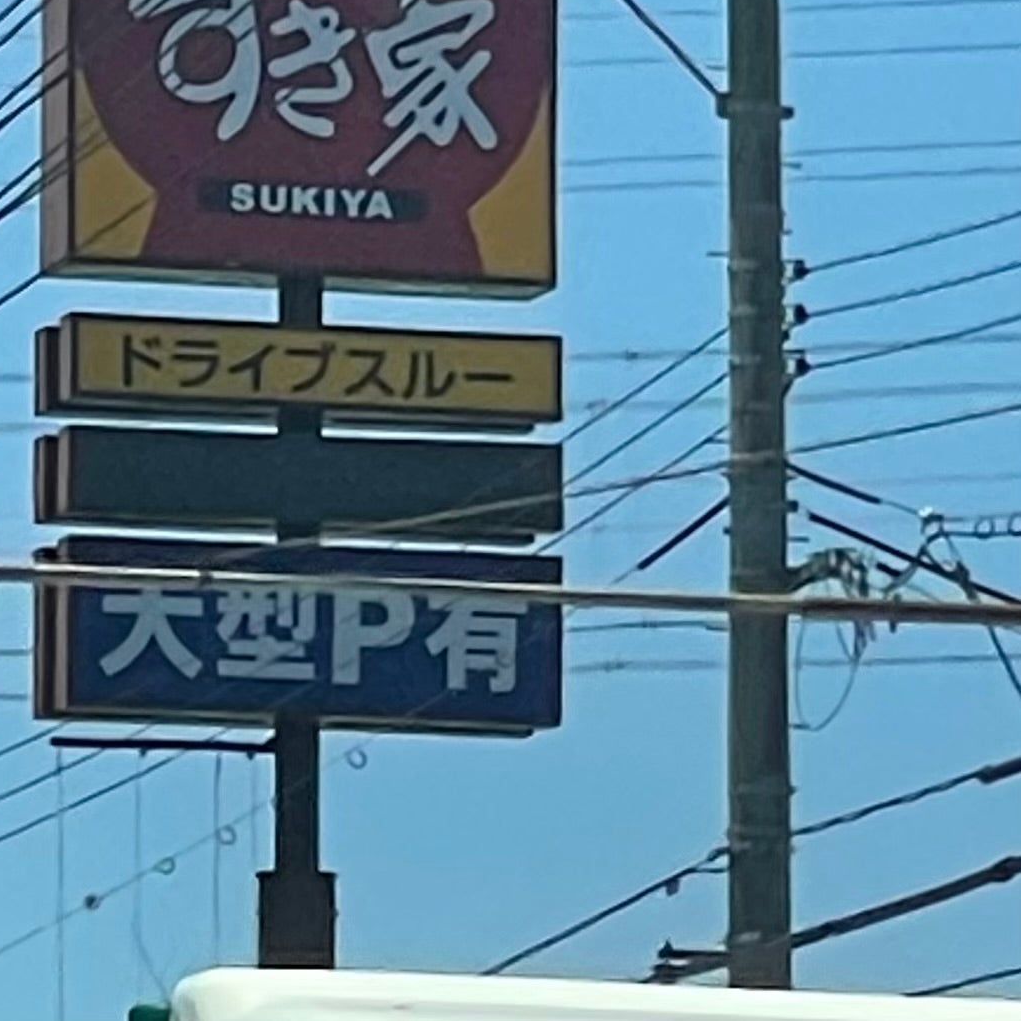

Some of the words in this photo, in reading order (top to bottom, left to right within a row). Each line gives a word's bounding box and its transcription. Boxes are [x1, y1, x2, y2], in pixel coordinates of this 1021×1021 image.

[229, 182, 394, 220] SUKIYA
[120, 333, 515, 400] ドライブスルー
[98, 583, 530, 695] 大型P有
